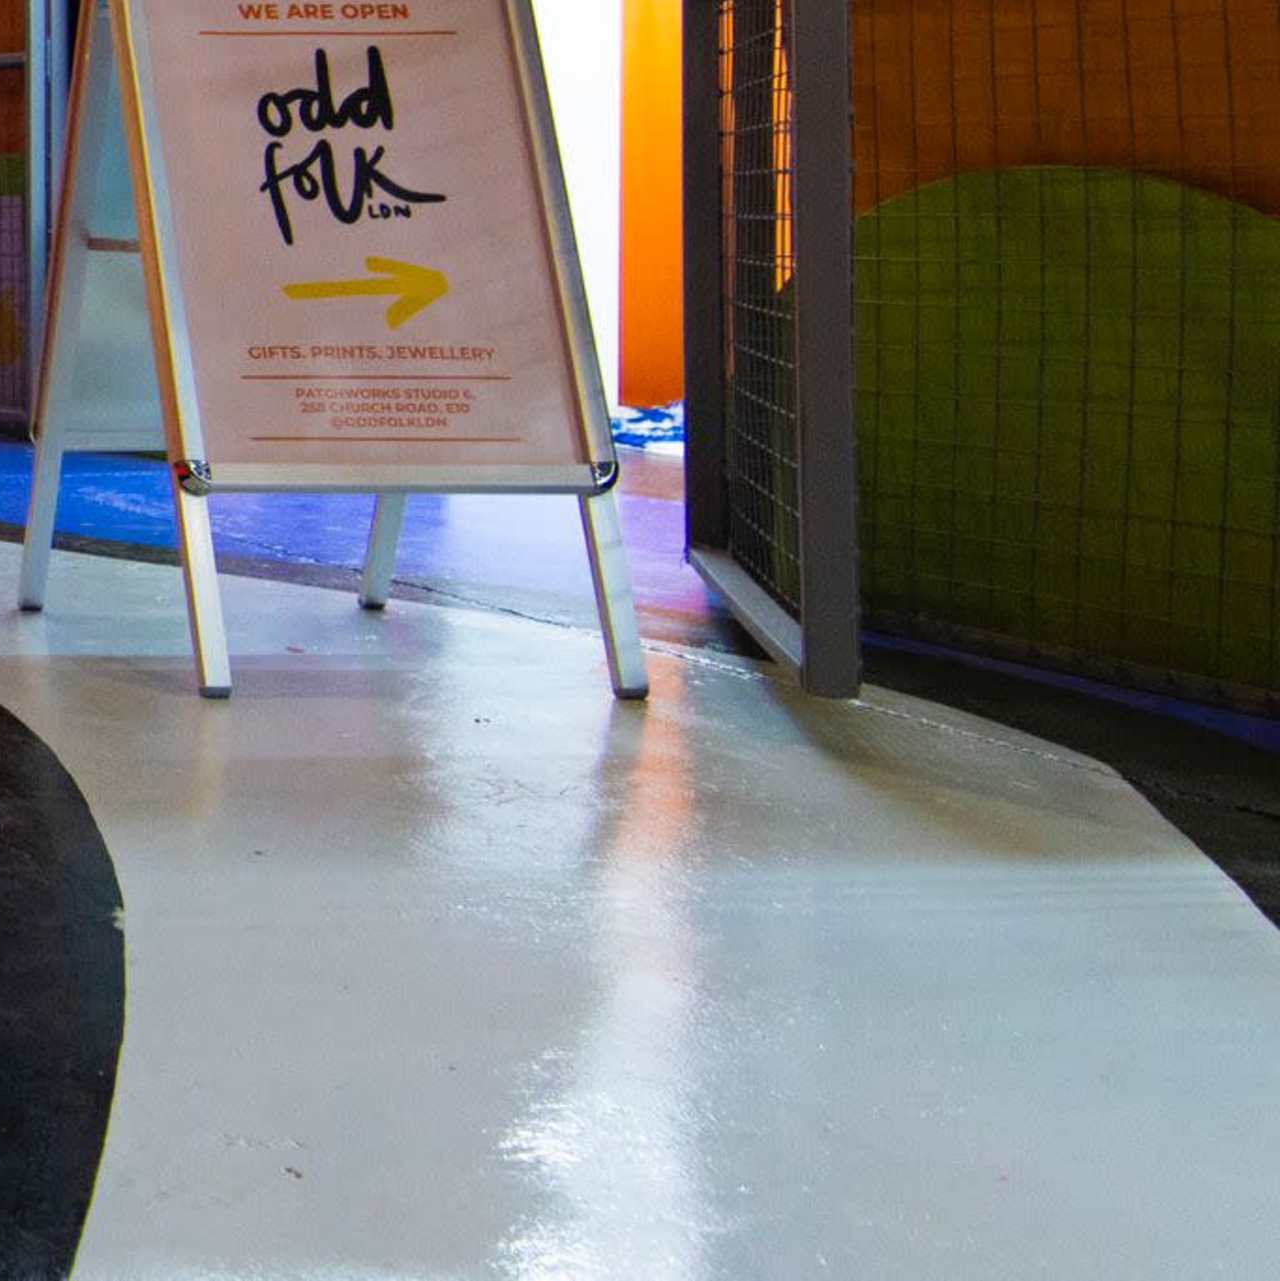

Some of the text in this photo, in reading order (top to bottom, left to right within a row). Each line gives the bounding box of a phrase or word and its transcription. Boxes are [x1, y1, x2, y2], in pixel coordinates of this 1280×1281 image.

[238, 2, 410, 20] WE ARE OPEN
[257, 45, 394, 138] odd
[367, 203, 412, 220] LDN
[386, 346, 497, 362] JEWELLERY
[294, 388, 400, 401] PATCHWORKS
[403, 388, 460, 401] STUDIO
[329, 402, 391, 414] CHURCH
